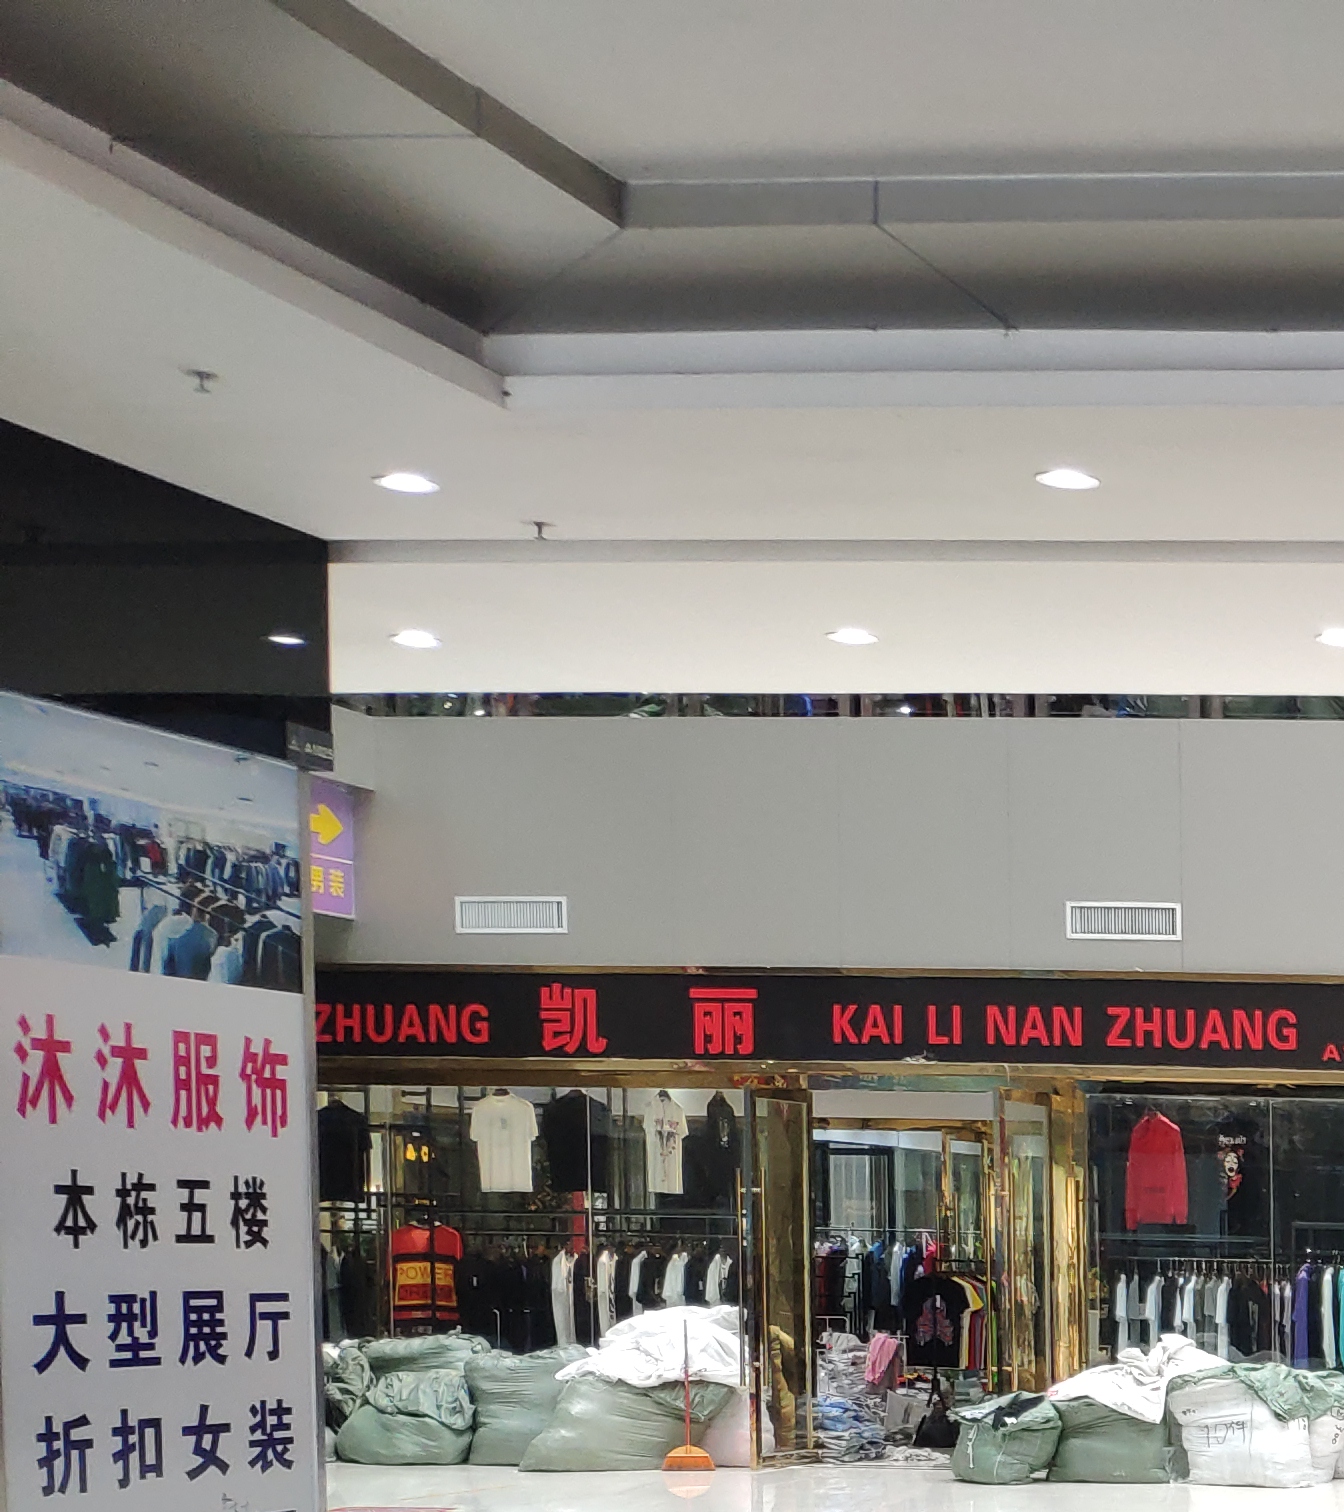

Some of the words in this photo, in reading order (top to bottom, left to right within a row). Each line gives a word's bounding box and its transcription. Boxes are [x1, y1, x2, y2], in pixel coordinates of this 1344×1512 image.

[316, 1003, 491, 1045] ZHUANG
[832, 1003, 902, 1045] KAI
[927, 1005, 963, 1045] LI
[986, 1006, 1083, 1046] NAN
[1106, 1007, 1299, 1052] ZHUANG
[14, 1012, 290, 1139] 沐沐服饰
[53, 1168, 271, 1250] 本栋五楼
[32, 1289, 292, 1375] 大型展厅
[36, 1399, 295, 1498] 折扣女装
